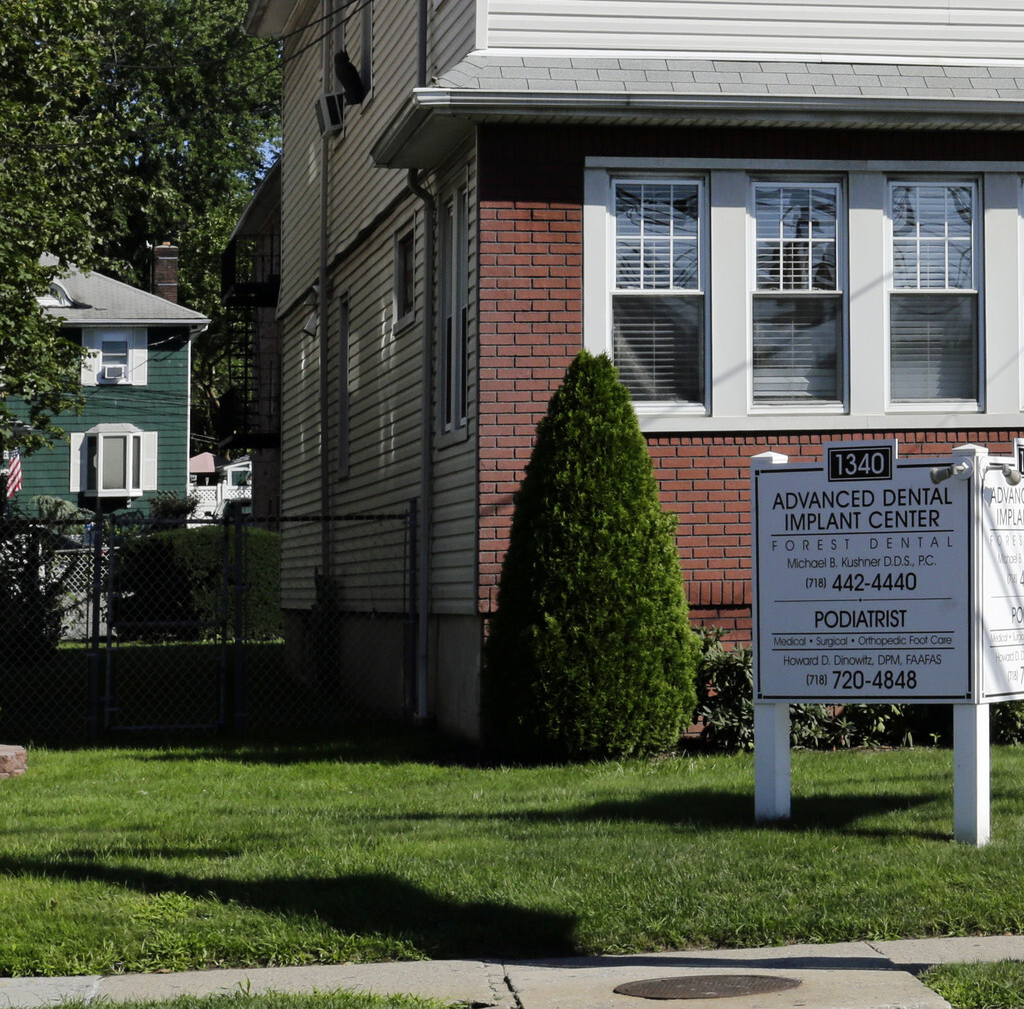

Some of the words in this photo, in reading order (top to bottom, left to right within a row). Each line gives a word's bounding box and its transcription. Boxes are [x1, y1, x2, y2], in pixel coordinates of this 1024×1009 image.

[835, 452, 885, 475] 1340
[772, 490, 875, 510] ADVANCED
[883, 487, 952, 507] DENTAL
[785, 512, 861, 531] IMPLANT
[868, 509, 940, 529] CENTER
[772, 538, 850, 551] FOREST
[869, 536, 953, 550] DENTAL
[787, 557, 827, 569] Michael
[829, 557, 838, 568] B.
[841, 556, 881, 568] Kushner
[883, 555, 915, 567] D.D.S.,
[918, 555, 937, 566] P.C.
[805, 577, 827, 589] (718)
[832, 572, 917, 592] 442-4440
[815, 610, 907, 629] PODIATRIST
[773, 636, 807, 646] Medical
[816, 636, 848, 647] Surgical
[858, 635, 907, 646] Orthopedic
[909, 635, 928, 645] Foot
[930, 634, 953, 645] Care
[783, 655, 819, 666] Howard
[821, 655, 831, 666] D.
[833, 654, 874, 666] Dinowitz,
[877, 654, 903, 666] DPM,
[906, 654, 942, 665] FAAFAS
[806, 674, 828, 686] (718)
[832, 670, 917, 690] 720-4848
